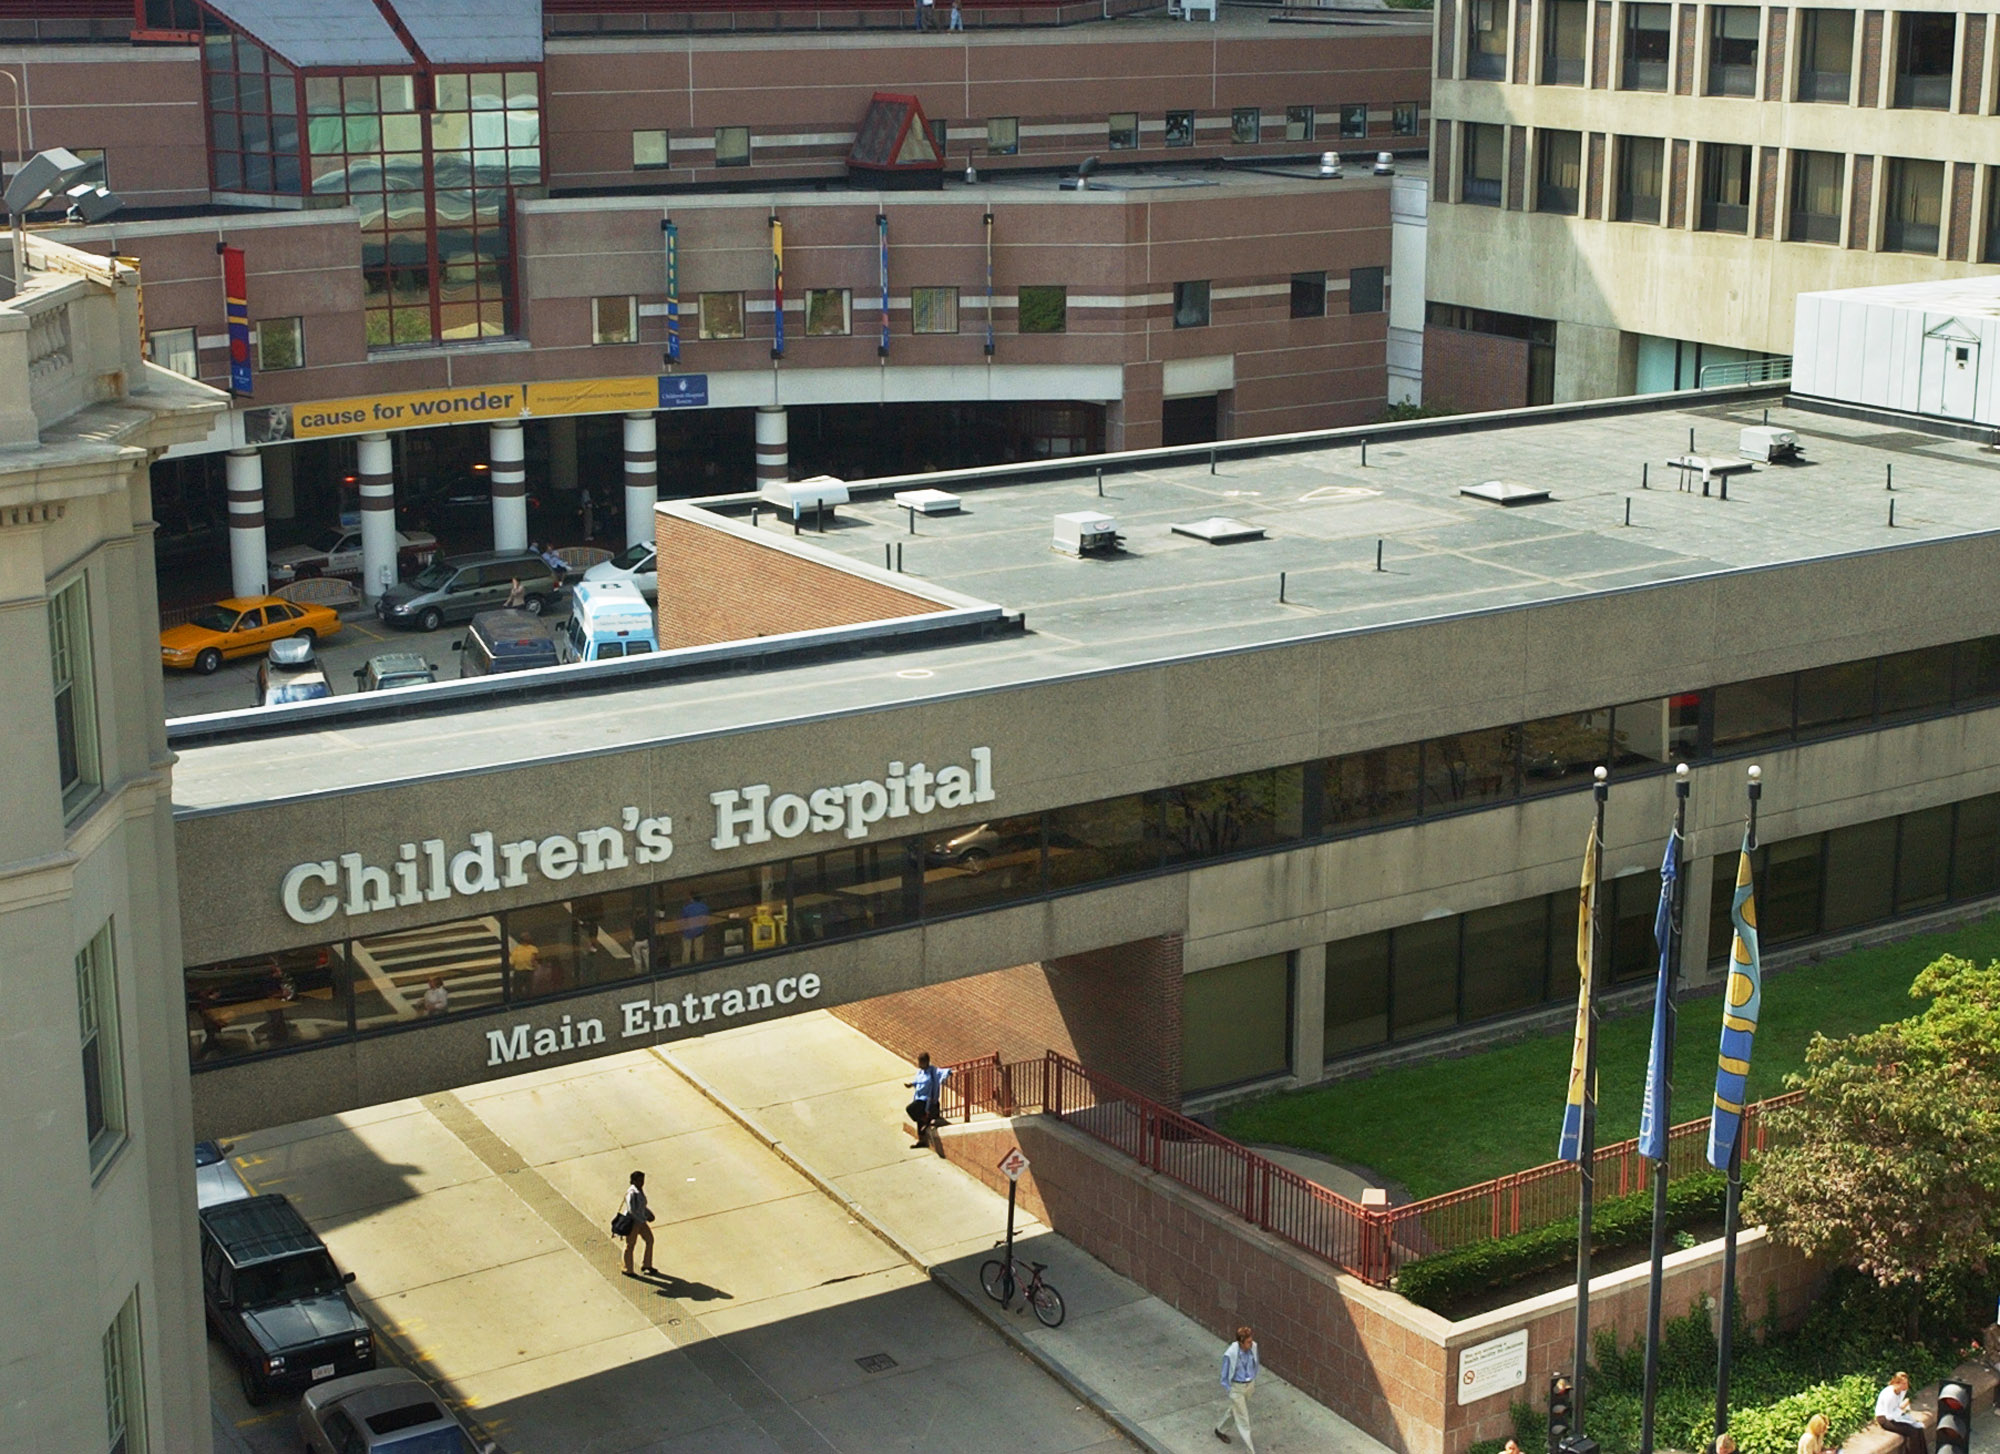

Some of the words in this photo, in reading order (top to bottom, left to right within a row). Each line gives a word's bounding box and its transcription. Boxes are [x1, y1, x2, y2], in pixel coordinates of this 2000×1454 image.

[300, 406, 364, 429] cause
[373, 402, 405, 421] for
[281, 806, 674, 924] Children's
[709, 746, 996, 850] Hospital
[486, 1014, 606, 1067] Main
[620, 972, 822, 1038] Entrance
